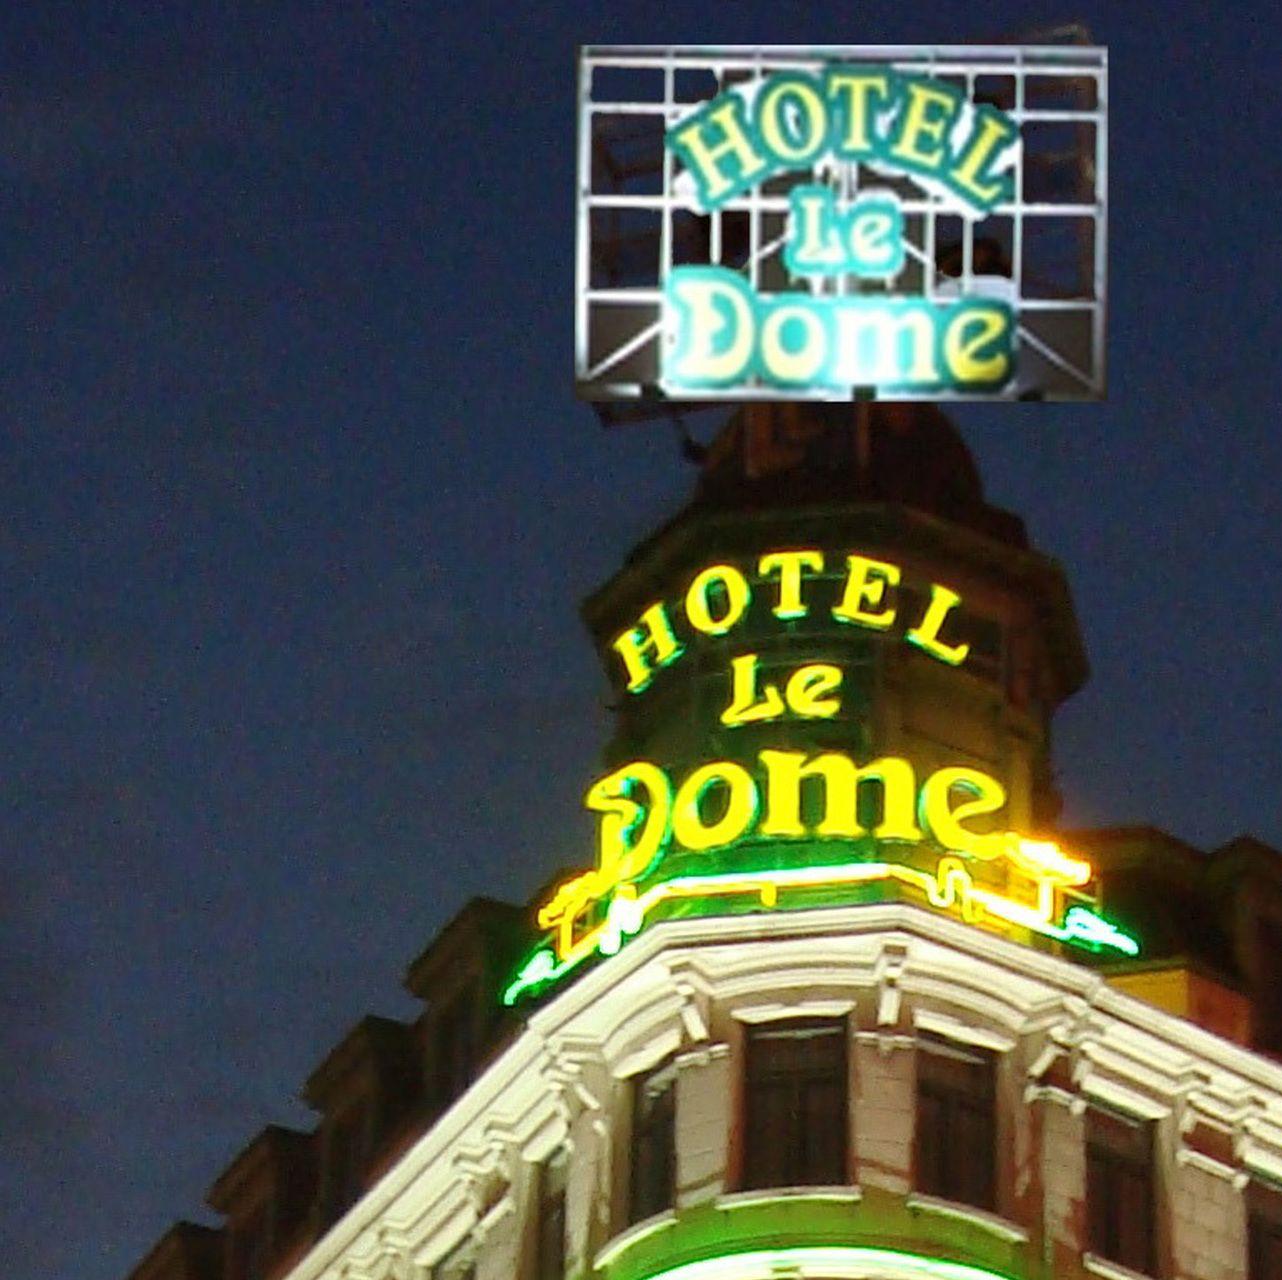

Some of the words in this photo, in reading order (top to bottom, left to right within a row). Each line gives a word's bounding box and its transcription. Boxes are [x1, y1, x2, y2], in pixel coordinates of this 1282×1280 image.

[672, 71, 1015, 202] HOTEL
[788, 191, 900, 268] Le
[668, 275, 1010, 384] Dome
[612, 550, 970, 695] HOTEL
[720, 654, 845, 727] Le
[586, 749, 1006, 885] Dome
